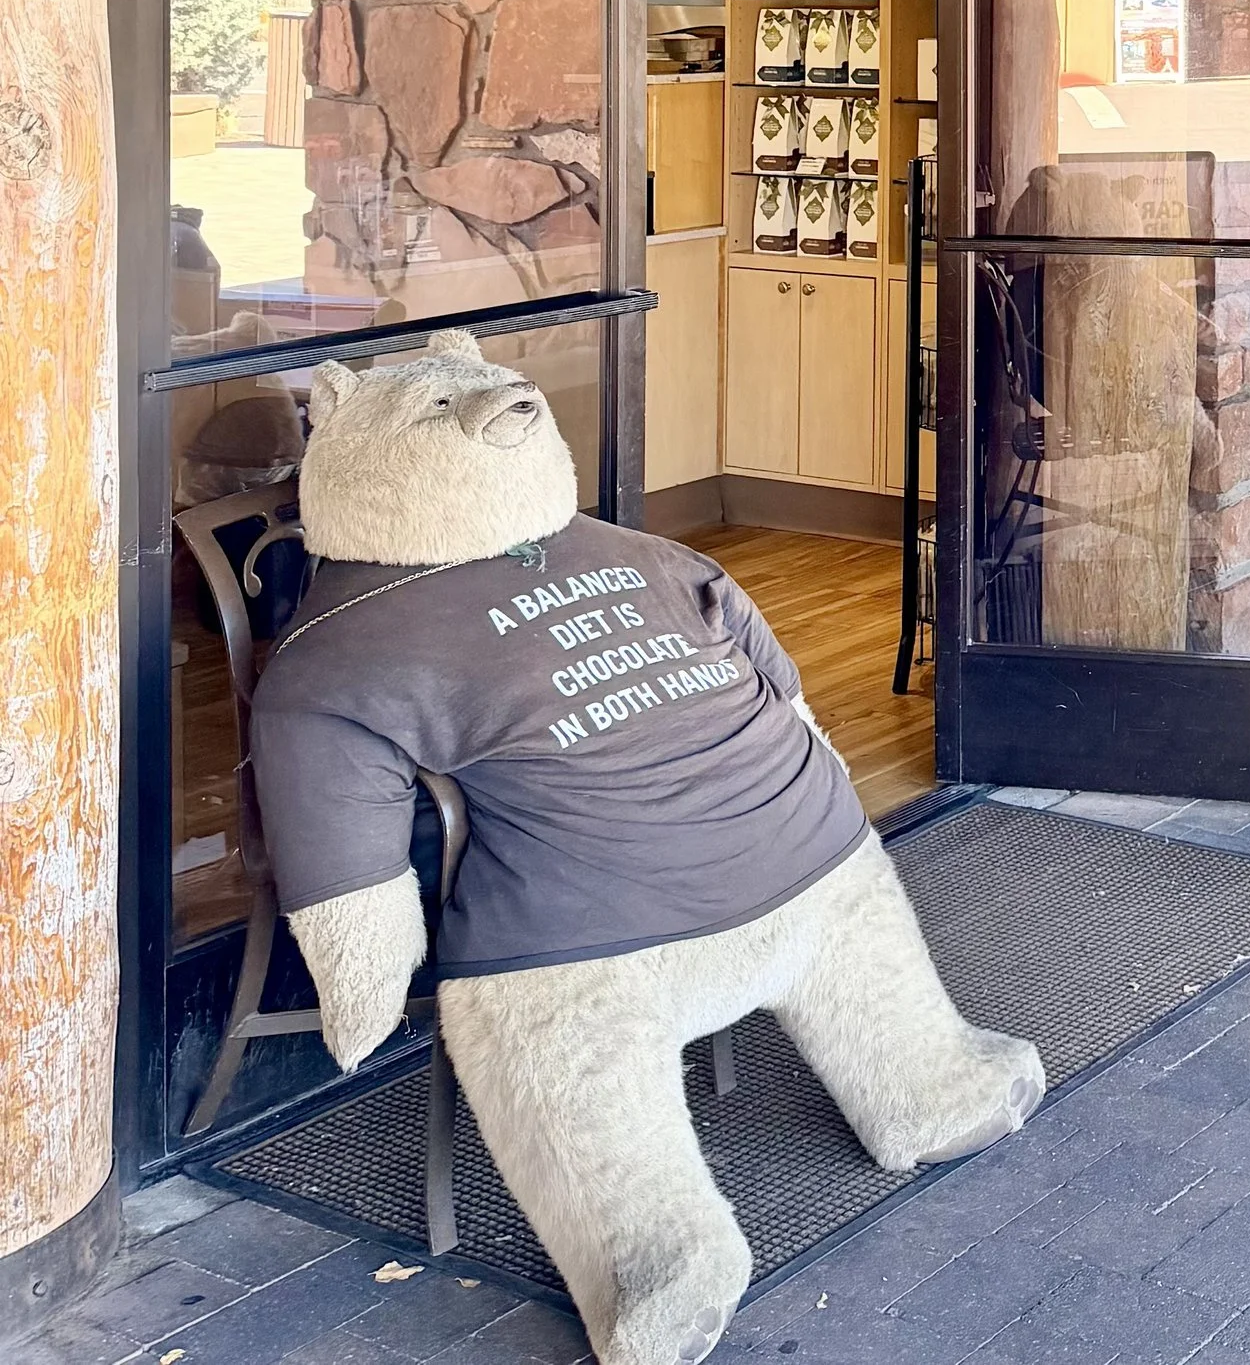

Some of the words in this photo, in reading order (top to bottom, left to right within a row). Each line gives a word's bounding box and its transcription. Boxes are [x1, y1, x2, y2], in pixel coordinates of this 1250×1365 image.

[487, 607, 518, 636] A
[510, 566, 648, 622] BALANCED
[548, 609, 613, 651] DIET
[611, 602, 645, 630] IS
[551, 633, 700, 698] CHOCOLATE
[548, 712, 589, 749] IN
[584, 681, 663, 732] BOTH
[657, 658, 740, 702] HANDS
